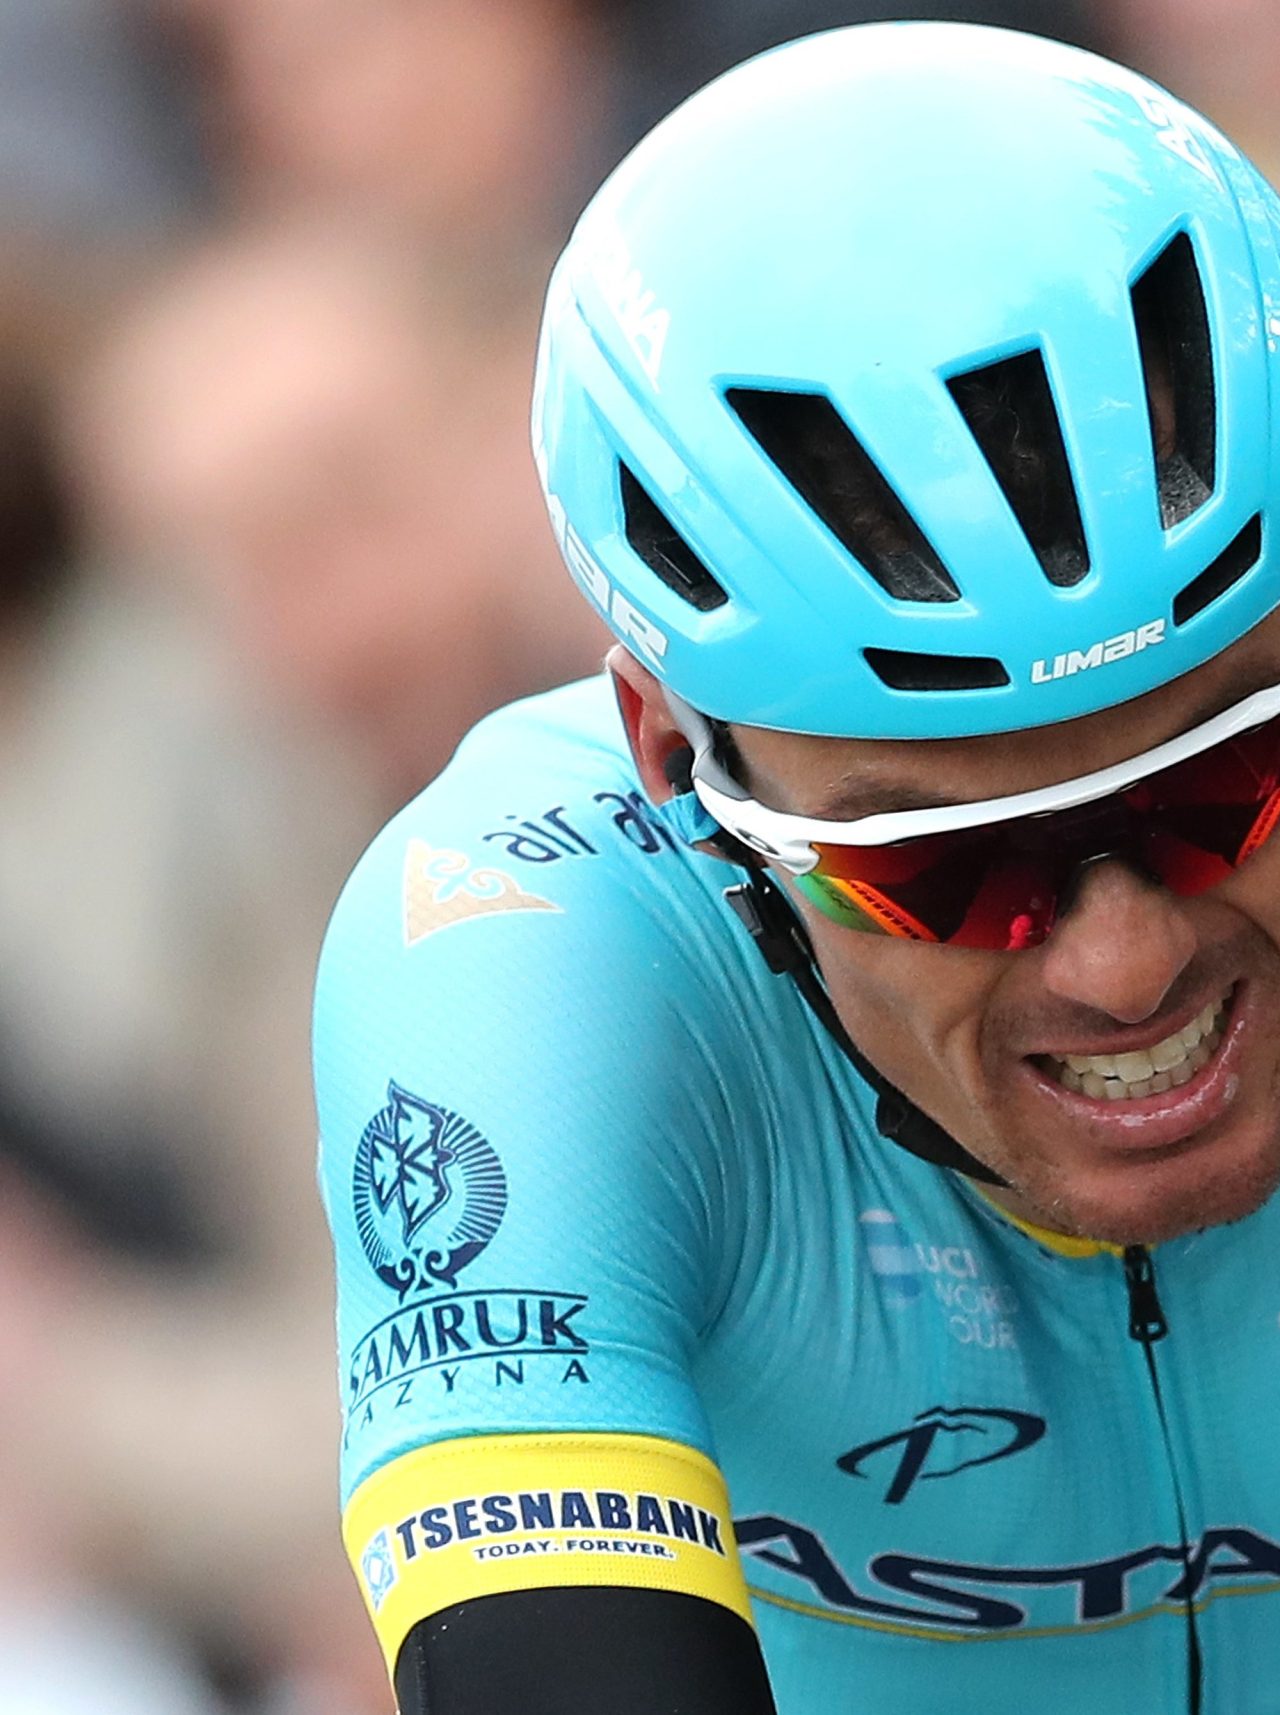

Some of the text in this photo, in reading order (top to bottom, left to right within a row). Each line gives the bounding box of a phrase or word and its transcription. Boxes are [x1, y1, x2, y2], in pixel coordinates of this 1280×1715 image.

[482, 806, 599, 863] air
[914, 1243, 976, 1279] UCI
[349, 1299, 589, 1410] SAMRUK
[343, 1359, 591, 1451] AZYNA
[396, 1491, 727, 1560] TSESNABANK
[474, 1539, 675, 1560] TODAY. FOREVER.
